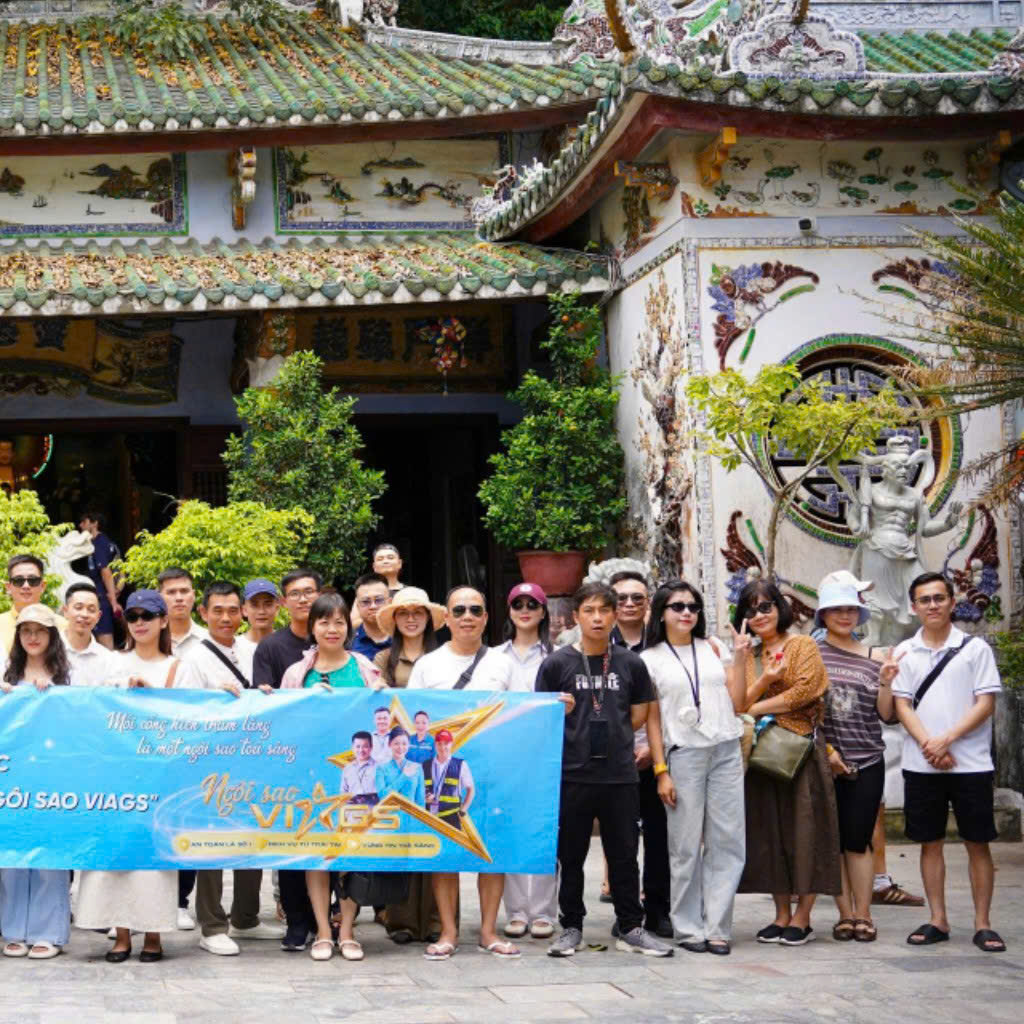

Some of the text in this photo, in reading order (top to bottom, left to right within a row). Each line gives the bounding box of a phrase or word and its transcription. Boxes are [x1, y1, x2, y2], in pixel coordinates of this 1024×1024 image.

[34, 792, 79, 810] SAO
[200, 773, 299, 817] Ngôi sao
